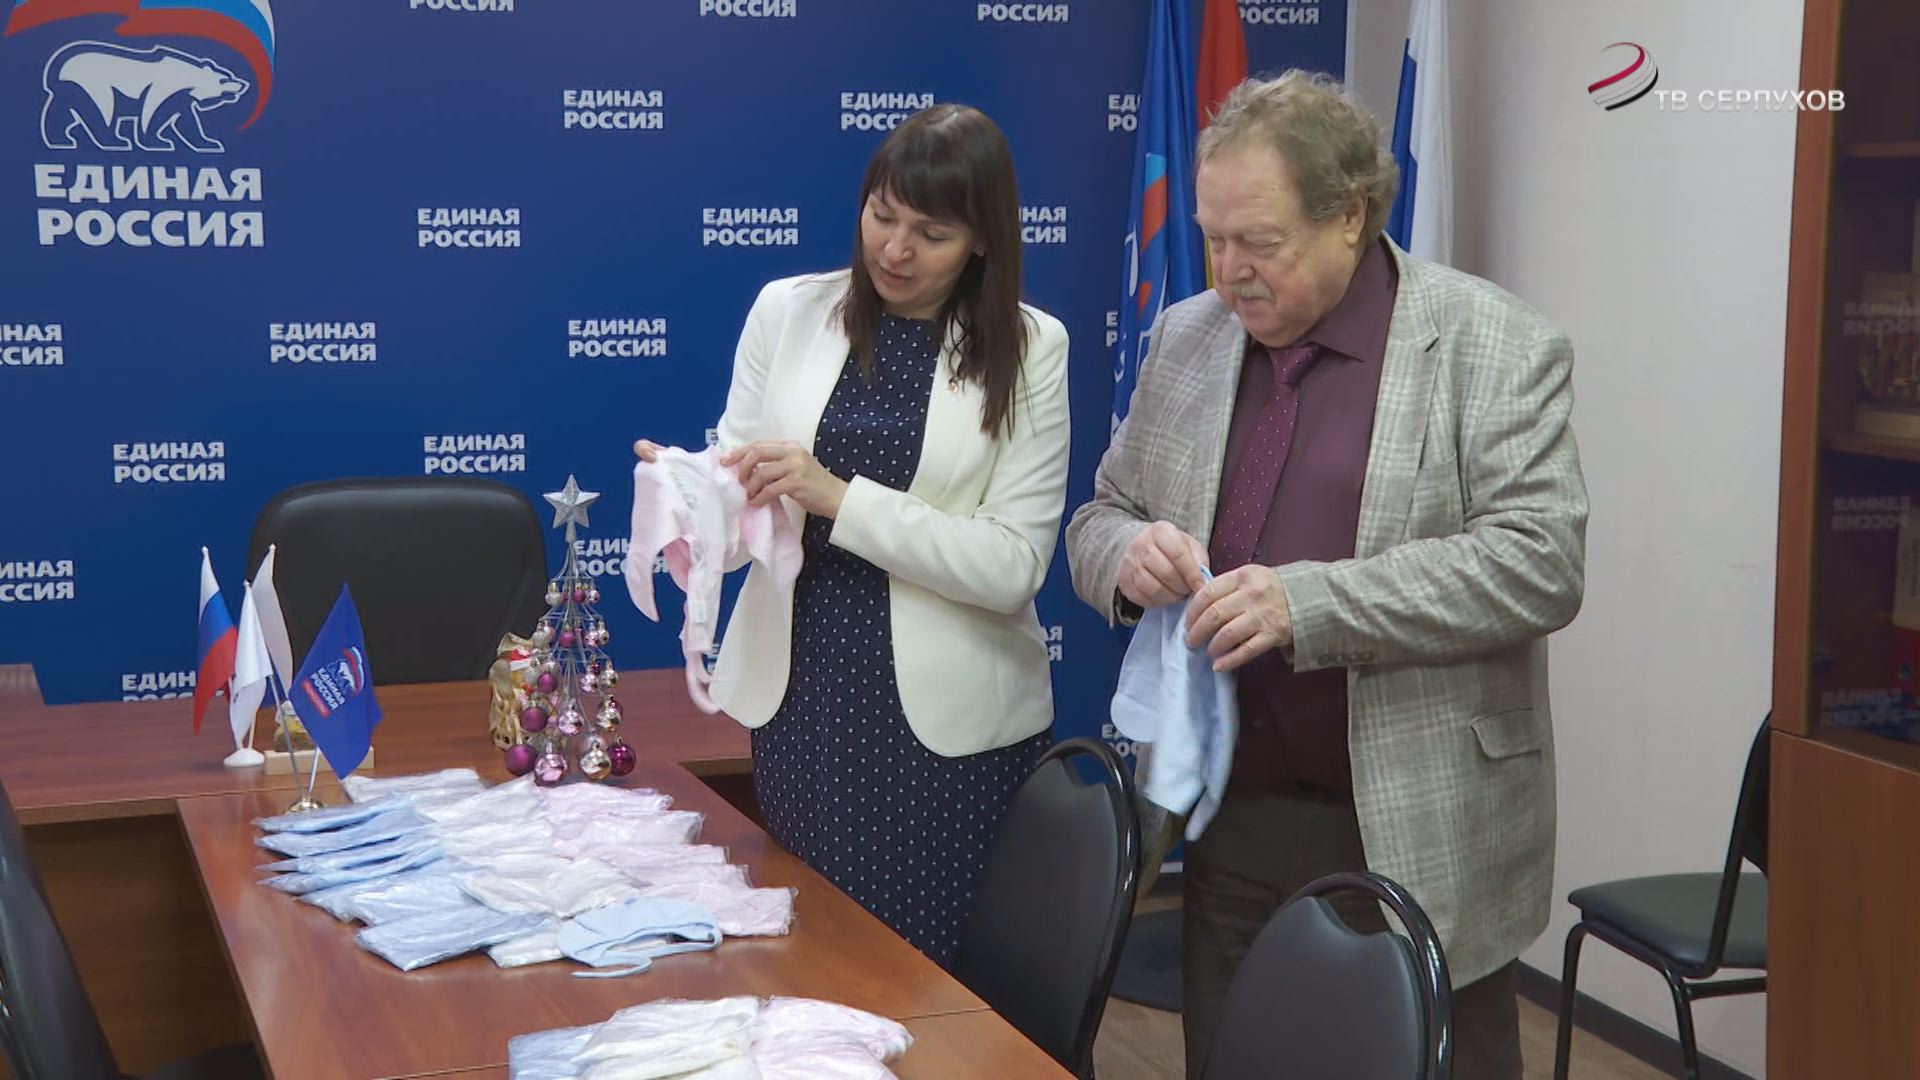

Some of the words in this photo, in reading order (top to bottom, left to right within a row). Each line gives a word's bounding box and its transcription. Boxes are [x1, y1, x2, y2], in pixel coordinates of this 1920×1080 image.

[700, 0, 797, 17] РОССИЯ
[977, 4, 1069, 21] РОССИЯ
[563, 90, 663, 109] ЕДИНАЯ
[841, 92, 934, 111] ЕДИНАЯ
[564, 110, 664, 129] РОССИЯ
[841, 113, 907, 131] РОСС
[34, 163, 263, 204] ЕДИНАЯ
[418, 208, 520, 227] ЕДИНАЯ
[703, 207, 799, 227] ЕДИНАЯ
[1018, 206, 1067, 223] НАЯ
[37, 208, 265, 247] РОССИЯ
[703, 227, 799, 246] РОССИЯ
[1021, 226, 1067, 243] СИЯ
[418, 228, 520, 248] РОССИЯ
[0, 324, 62, 342] НАЯ
[270, 322, 376, 342] ЕДИНАЯ
[568, 318, 666, 338] ЕДИНАЯ
[0, 346, 64, 366] СИЯ
[270, 342, 377, 362] РОССИЯ
[569, 338, 667, 357] РОССИЯ
[113, 441, 225, 464] ЕДИНАЯ
[424, 433, 525, 454] ЕДИНАЯ
[114, 462, 226, 484] РОССИЯ
[424, 453, 526, 474] РОССИЯ
[573, 538, 631, 557] ЕДИН
[0, 560, 74, 579] ИНАЯ
[0, 581, 75, 602] ССИЯ
[122, 671, 196, 692] ЕДИН
[310, 672, 339, 711] РОССИЯ
